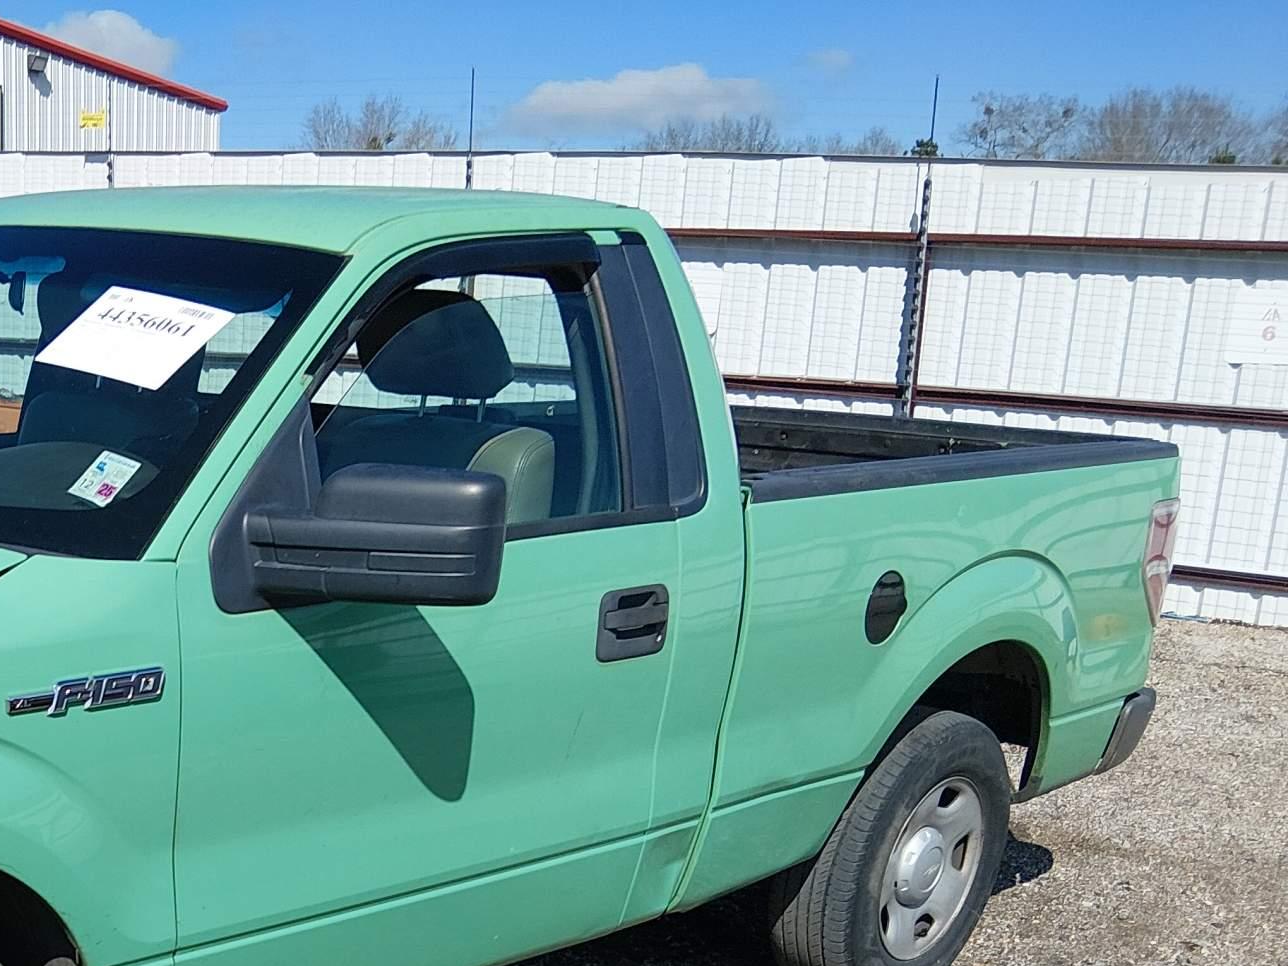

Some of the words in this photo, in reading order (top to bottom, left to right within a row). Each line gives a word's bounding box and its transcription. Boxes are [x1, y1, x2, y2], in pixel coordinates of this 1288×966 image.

[97, 307, 196, 337] 44356061
[1262, 325, 1276, 341] 6
[97, 483, 117, 497] 25
